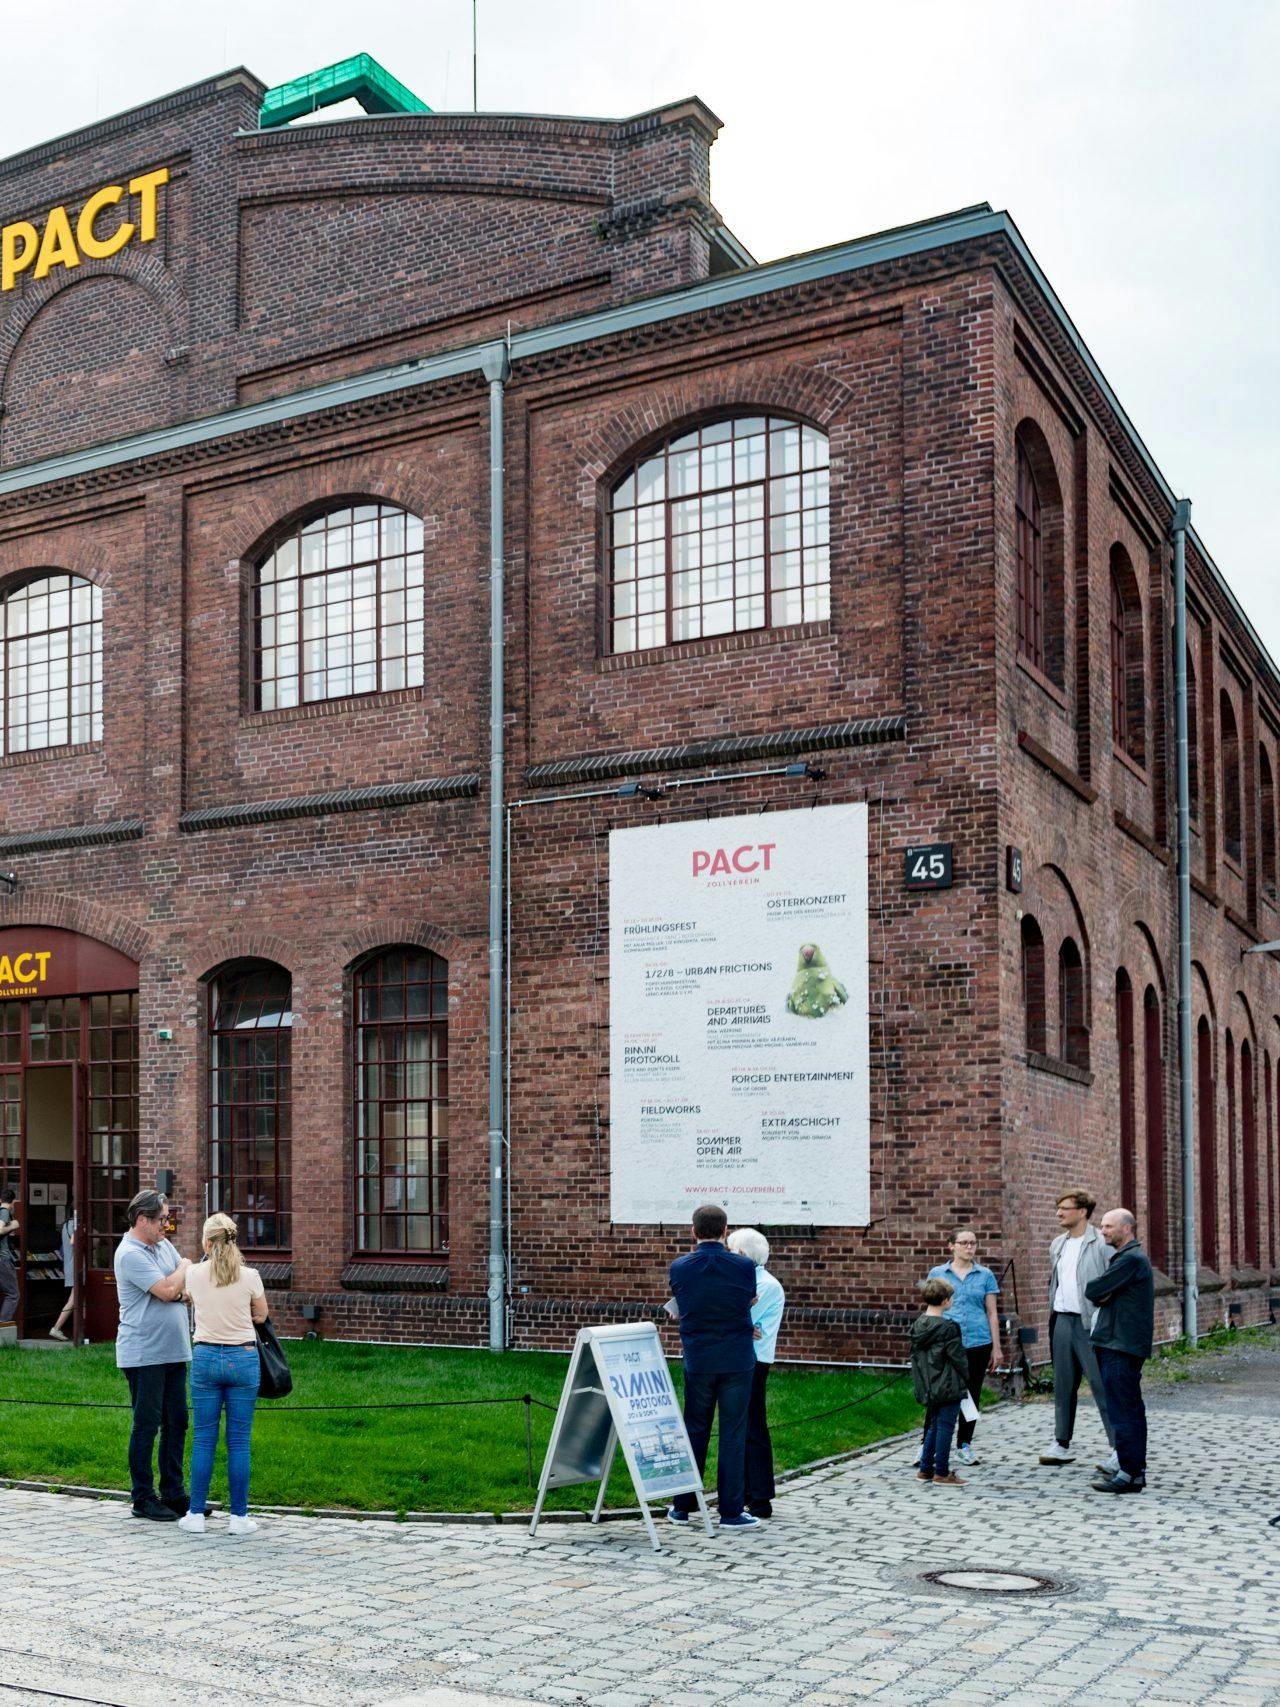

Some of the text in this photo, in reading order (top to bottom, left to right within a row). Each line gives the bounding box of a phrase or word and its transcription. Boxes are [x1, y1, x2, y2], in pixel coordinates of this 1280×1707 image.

[1, 168, 169, 291] PACT
[692, 843, 776, 877] PACT
[911, 854, 945, 880] 45
[1012, 857, 1021, 883] 45
[707, 877, 760, 888] ZOLLVEREIN
[766, 894, 847, 909] OSTERKONZERT
[623, 921, 697, 935] FRÜHLINGSFEST
[645, 969, 674, 979] 1/2/8
[685, 966, 717, 976] URBAN
[720, 962, 773, 974] FRICTIONS
[707, 1005, 766, 1016] DEPARTURES
[707, 1015, 771, 1026] AND ARRIVALS
[624, 1045, 656, 1055] RIMINI
[624, 1054, 680, 1065] PROTOKOLL
[731, 1071, 855, 1084] FORCED ENTERTAINMENT
[641, 1105, 701, 1115] FIELDWORKS
[761, 1117, 841, 1127] EXTRASCHICHT
[696, 1136, 741, 1146] SOMMER
[696, 1146, 742, 1156] OPEN AIR
[685, 1186, 785, 1194] WWW.PACT-ZOLLVEREIN.DE
[623, 1351, 641, 1362] PACT
[609, 1369, 671, 1398] RIMINI
